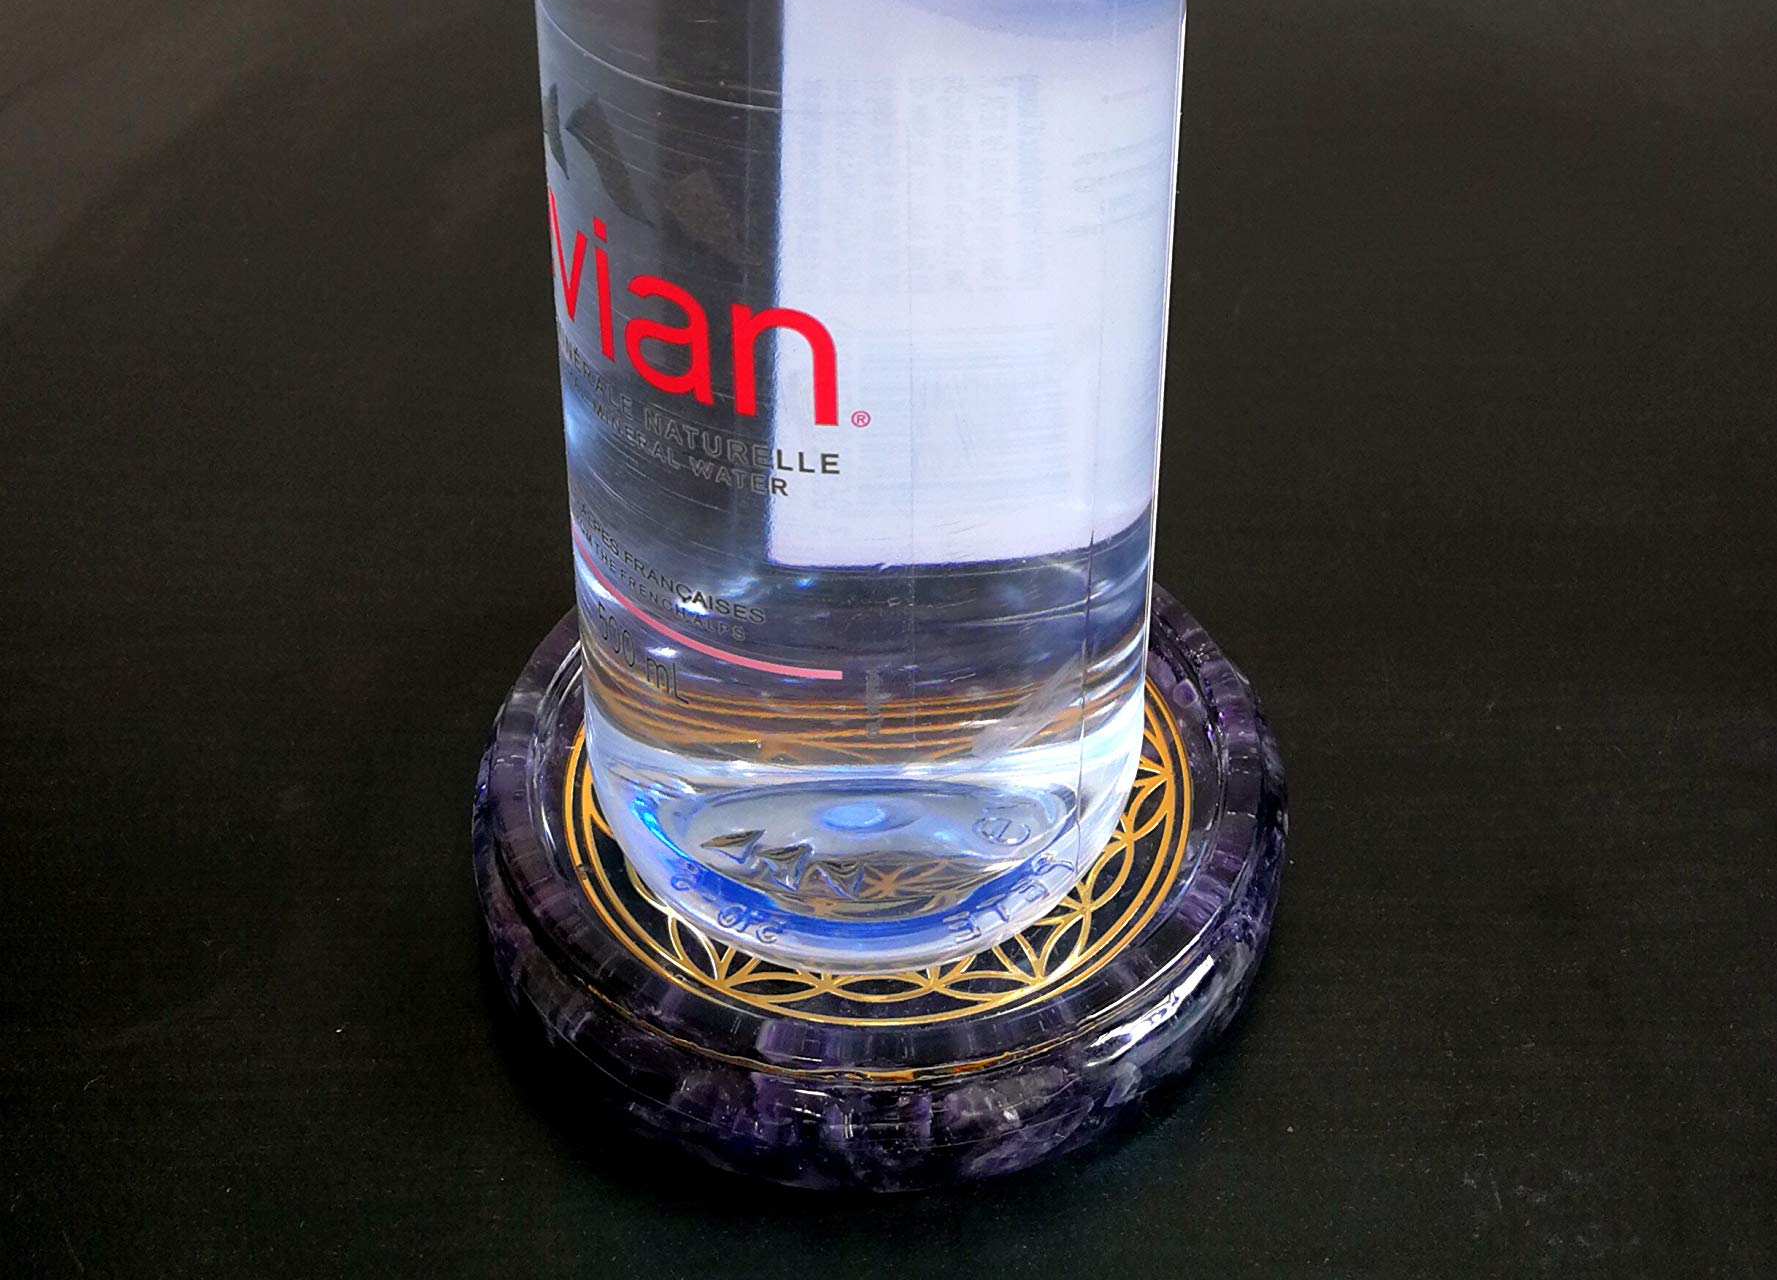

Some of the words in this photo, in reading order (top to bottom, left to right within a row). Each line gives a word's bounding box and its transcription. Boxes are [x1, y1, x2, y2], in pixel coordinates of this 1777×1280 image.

[548, 184, 839, 426] vian
[644, 407, 840, 474] NATURELLE
[689, 456, 789, 496] WATER
[595, 542, 617, 573] THE
[620, 569, 686, 620] FRENCH
[694, 614, 747, 642] ALPS
[624, 550, 766, 625] FRANÇAISES
[597, 600, 636, 668] 500
